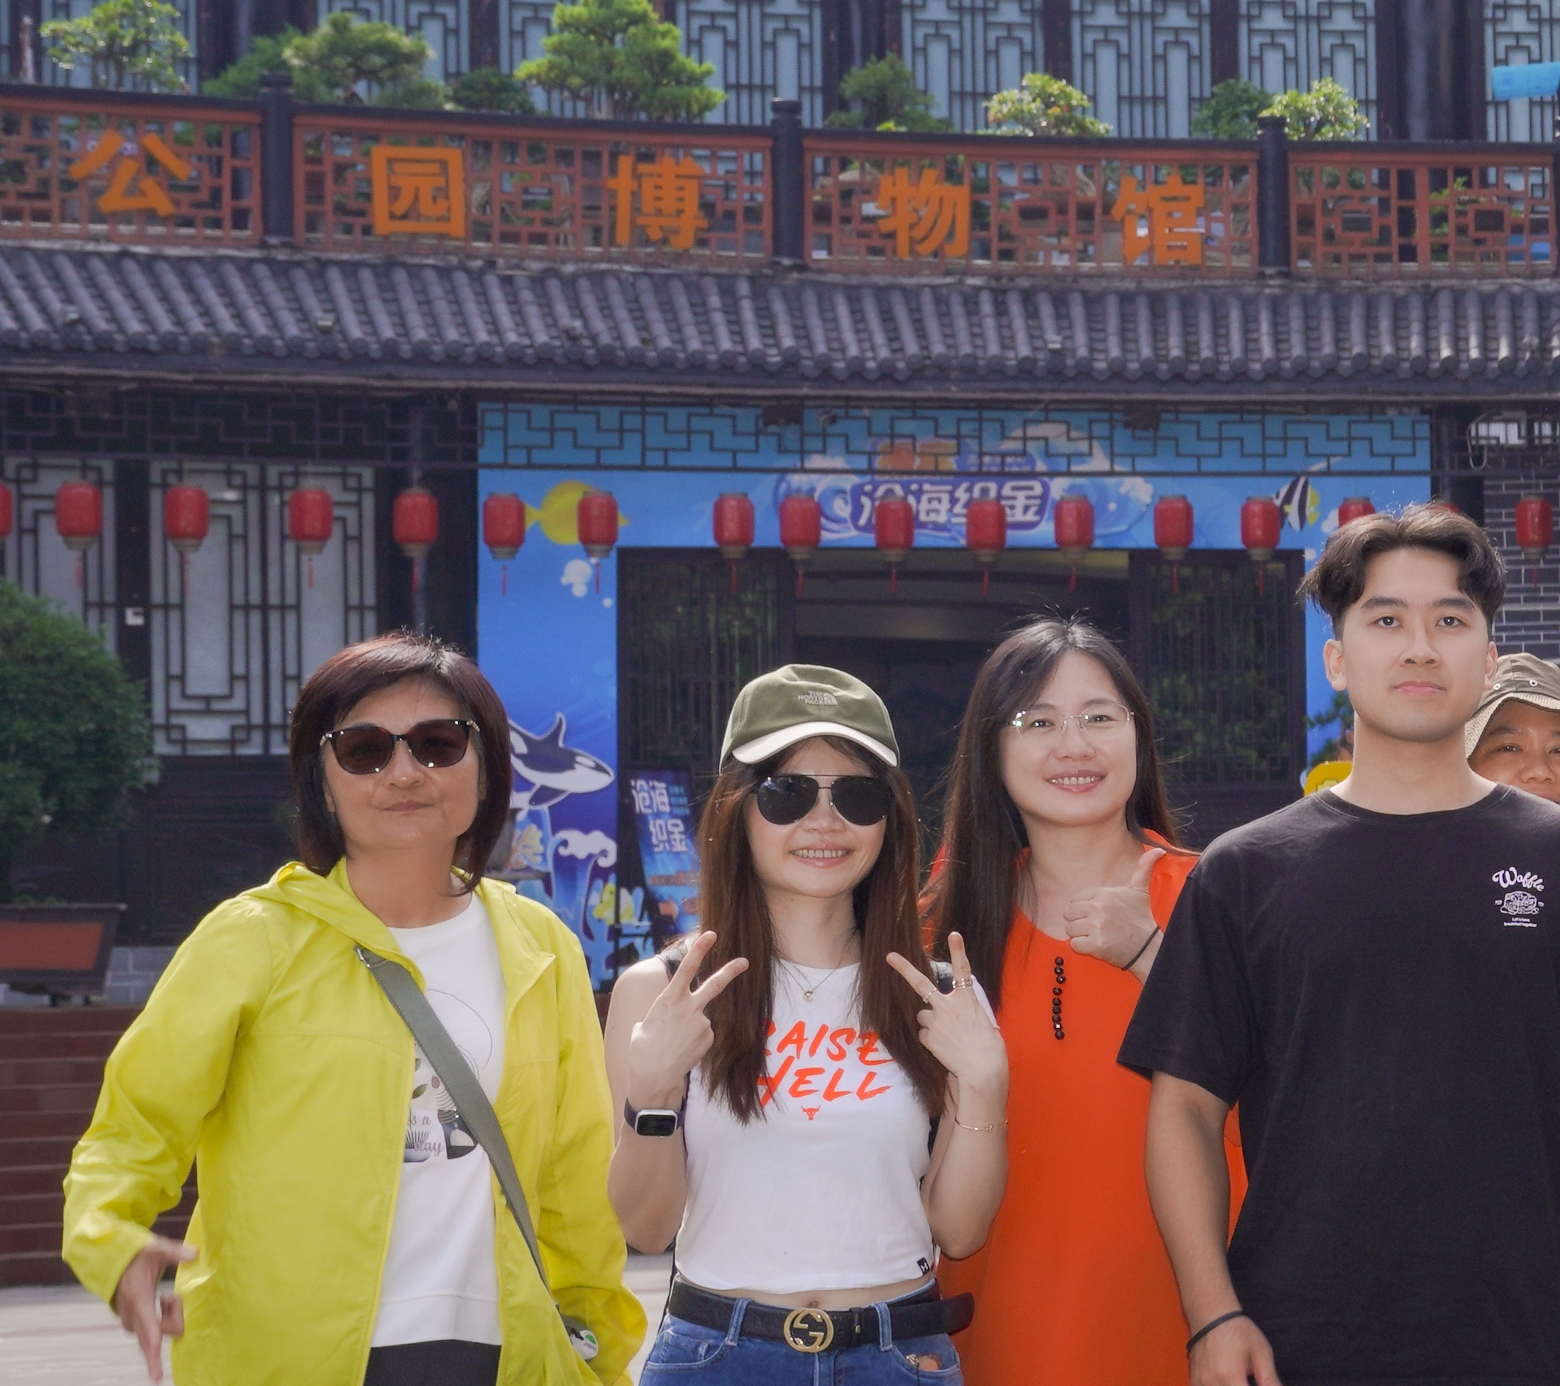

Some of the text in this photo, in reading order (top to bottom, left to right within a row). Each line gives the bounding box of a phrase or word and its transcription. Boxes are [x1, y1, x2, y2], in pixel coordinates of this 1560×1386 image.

[70, 128, 1206, 266] 公园博物馆
[1492, 866, 1545, 892] Waffle
